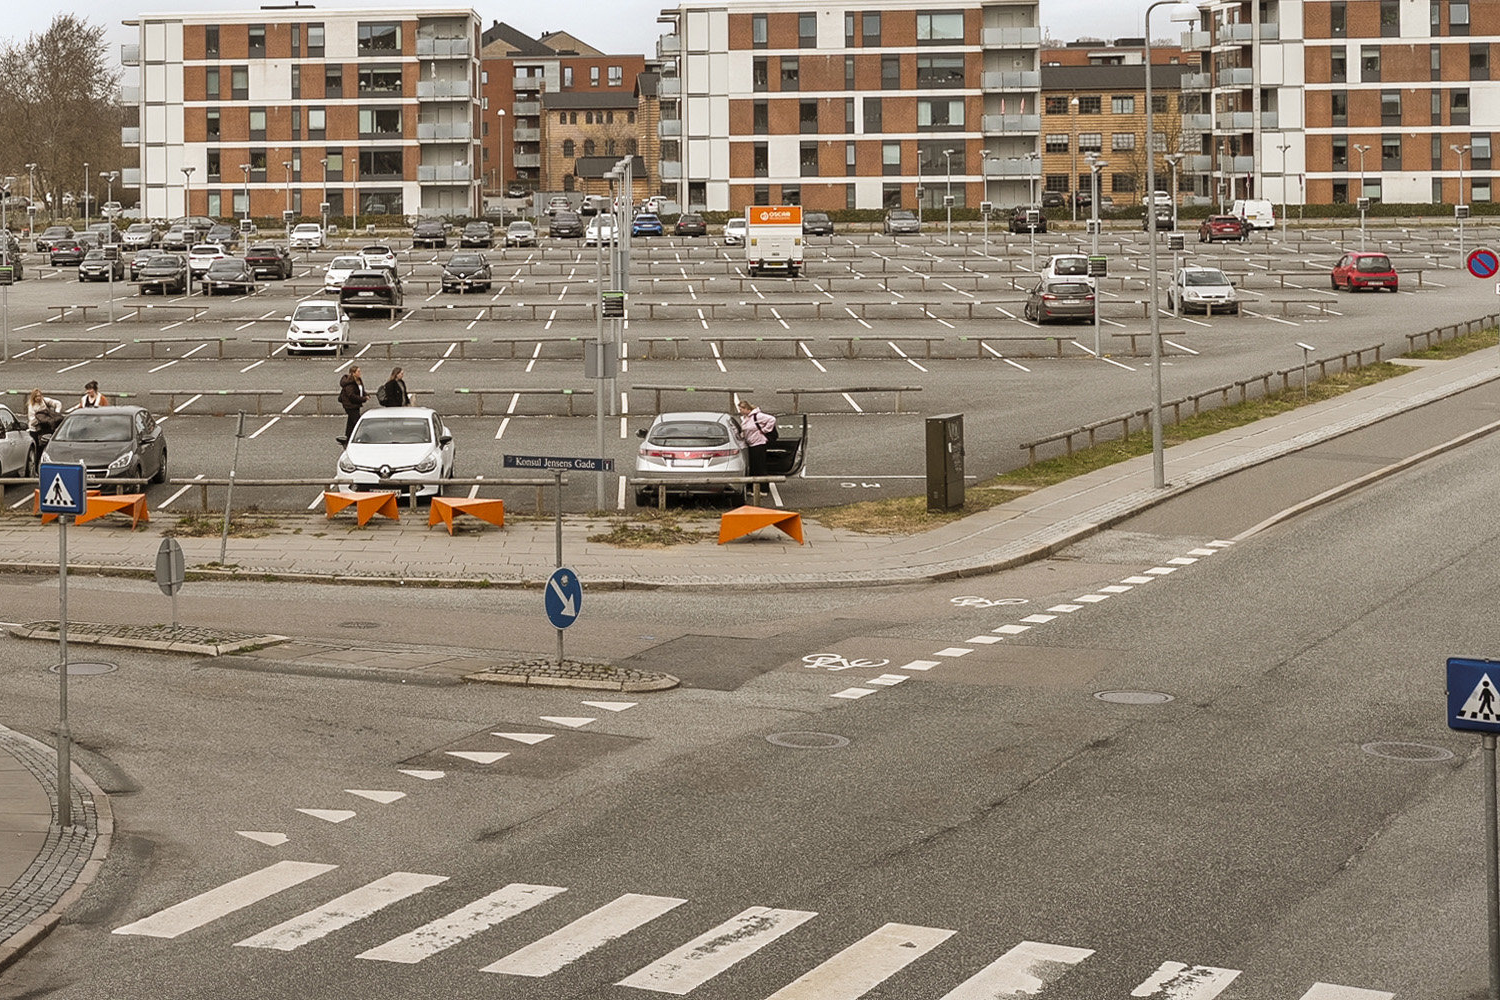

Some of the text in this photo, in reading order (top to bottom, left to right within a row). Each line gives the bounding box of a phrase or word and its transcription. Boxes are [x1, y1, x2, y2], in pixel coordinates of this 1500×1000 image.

[515, 457, 596, 469] Konsul Jensens Gade
